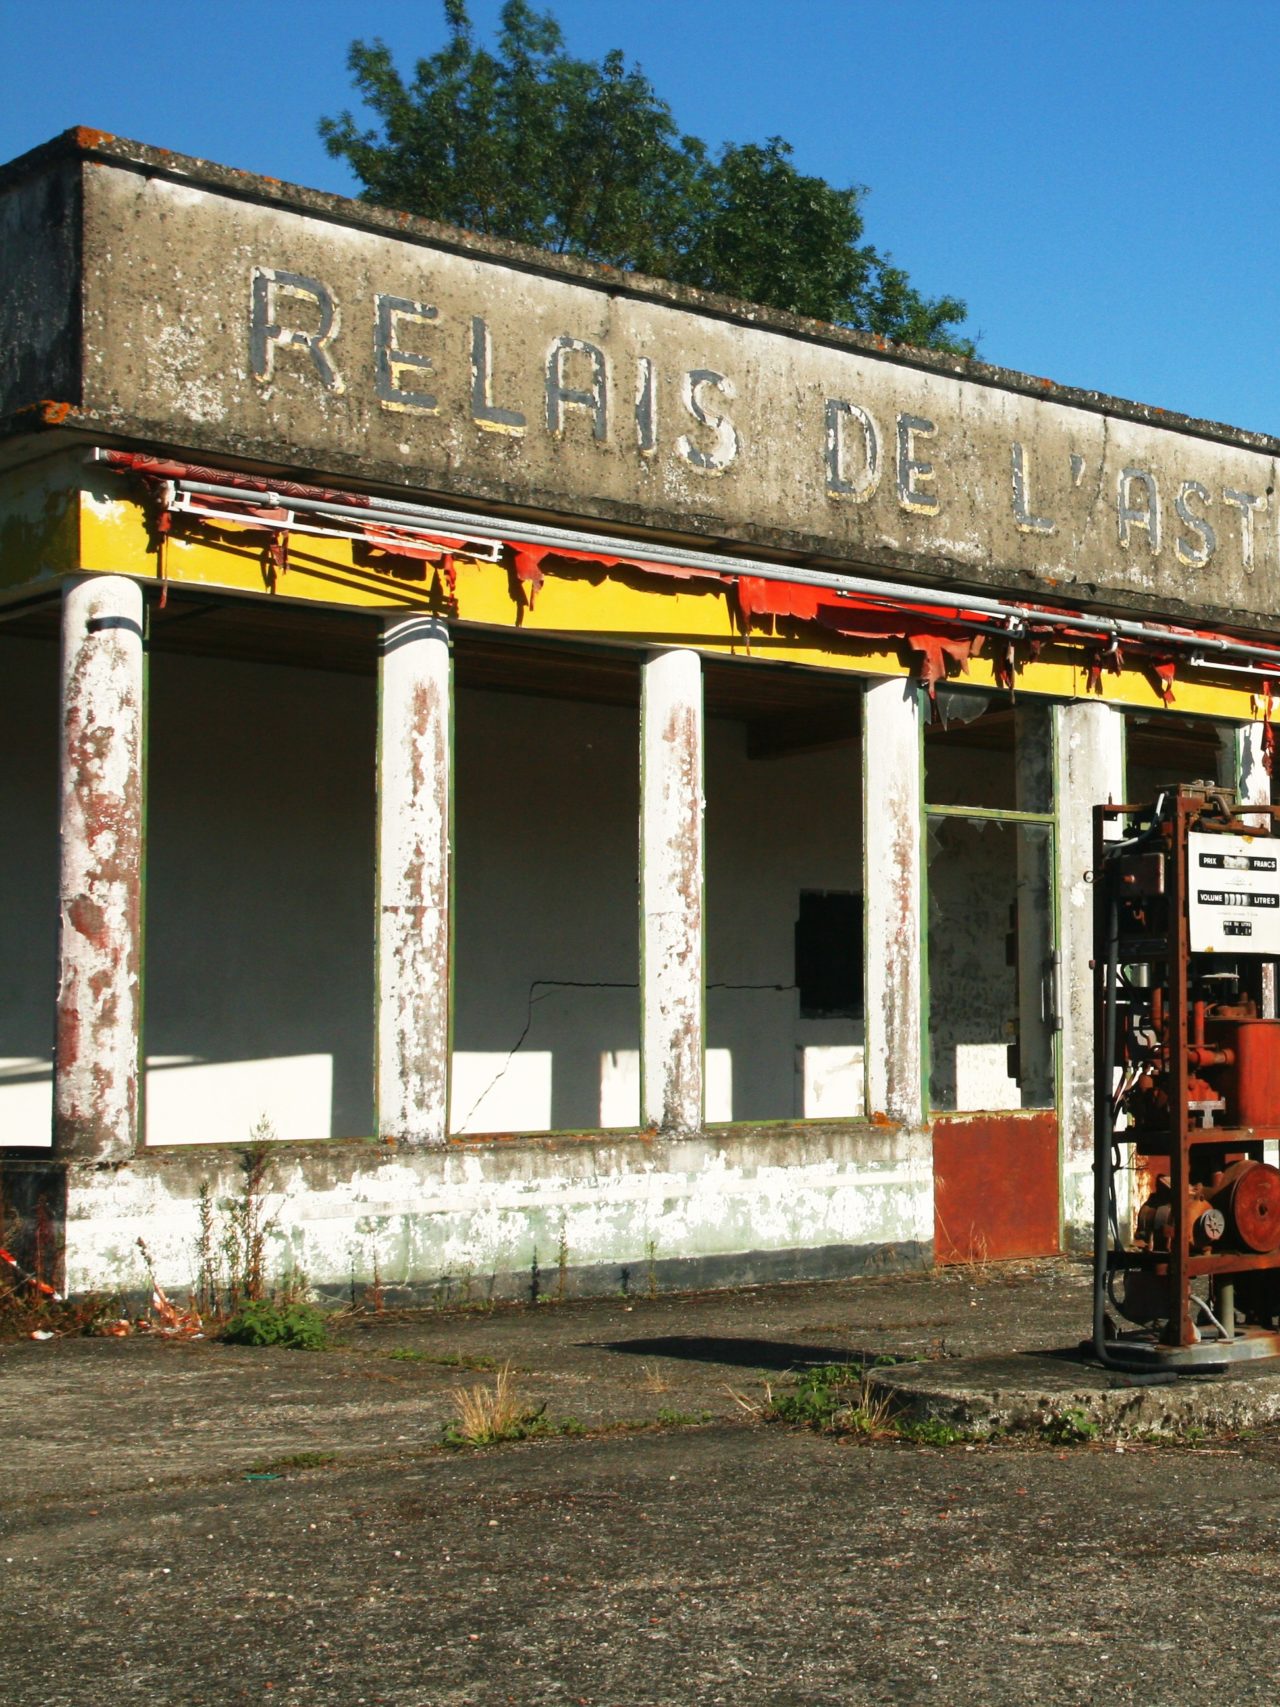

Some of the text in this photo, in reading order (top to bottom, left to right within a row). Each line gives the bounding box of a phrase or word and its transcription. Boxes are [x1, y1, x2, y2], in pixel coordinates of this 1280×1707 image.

[250, 266, 740, 478] RELAIS
[824, 398, 941, 517] DE
[1203, 856, 1276, 869] PRIX FRANCS
[1200, 893, 1276, 905] VOLUME LITRES
